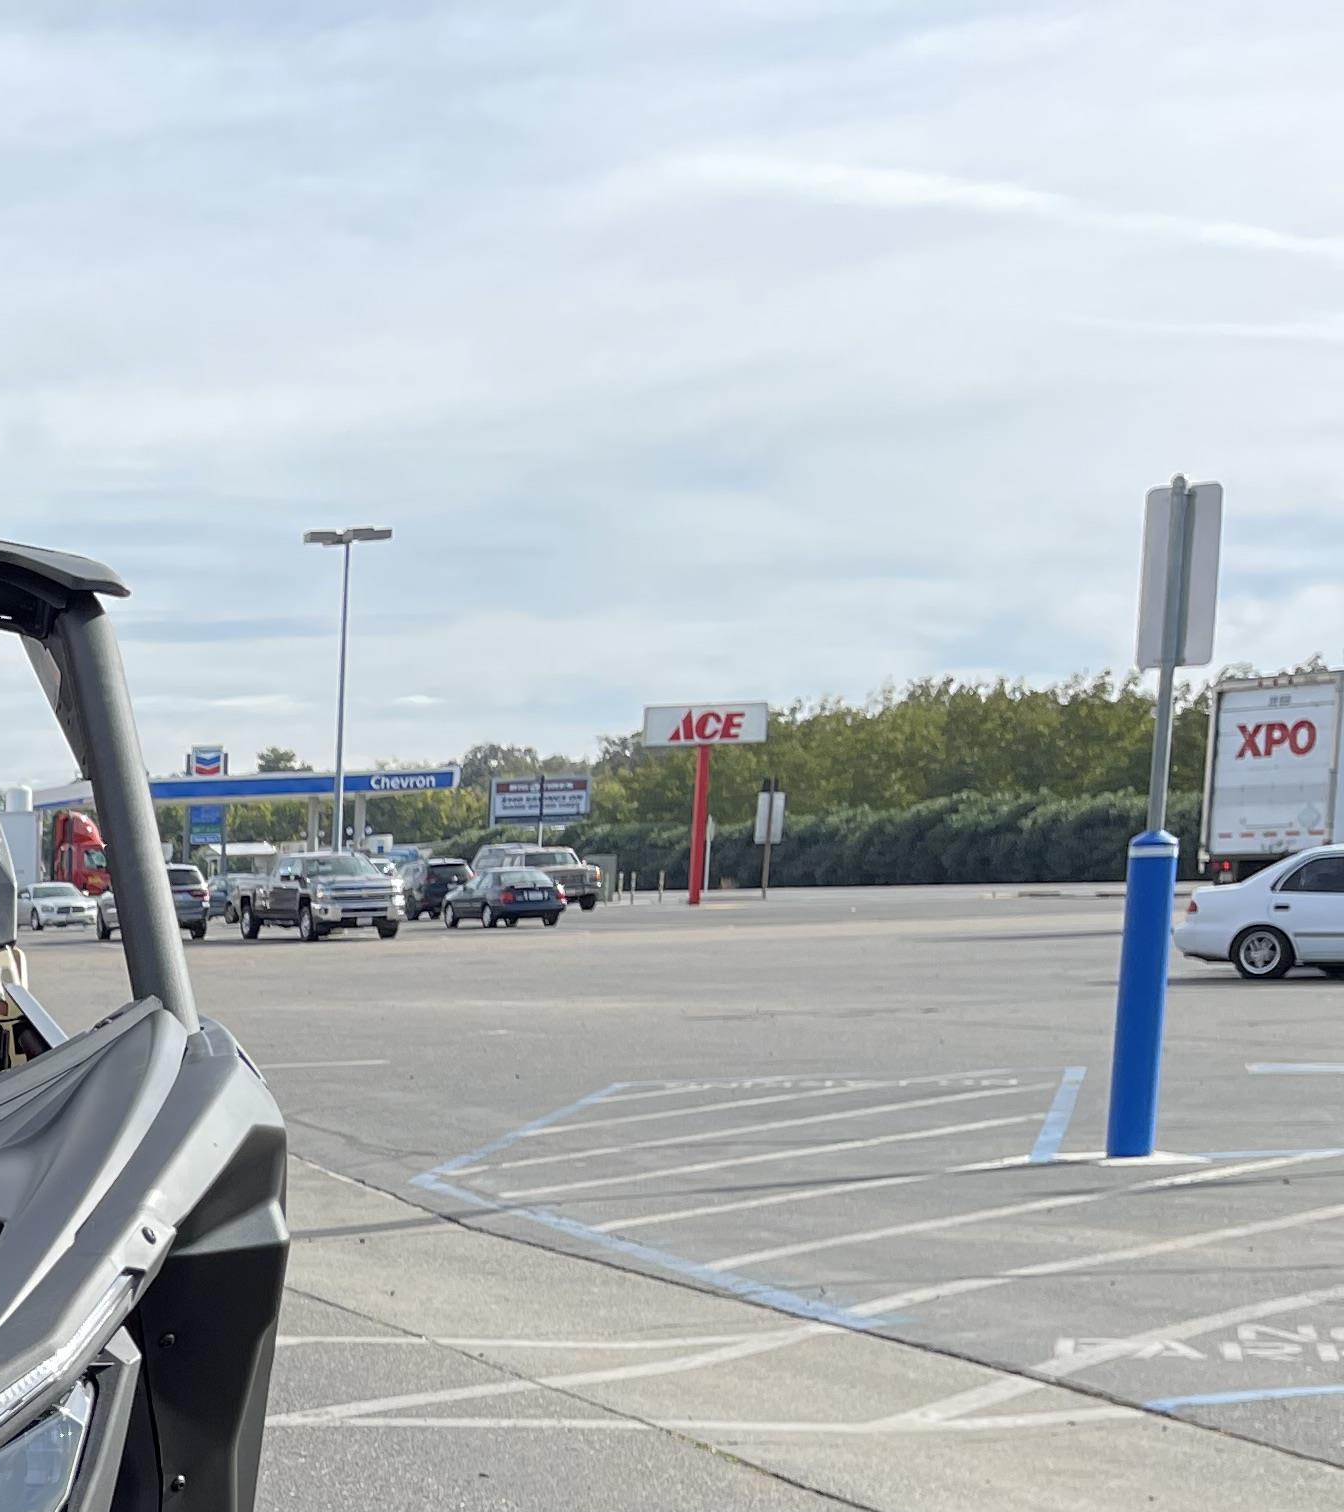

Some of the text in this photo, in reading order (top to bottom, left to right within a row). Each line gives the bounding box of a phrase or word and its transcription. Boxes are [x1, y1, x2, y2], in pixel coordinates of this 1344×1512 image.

[668, 709, 745, 741] ACE
[1236, 720, 1317, 760] XPO
[370, 775, 436, 790] Chevron
